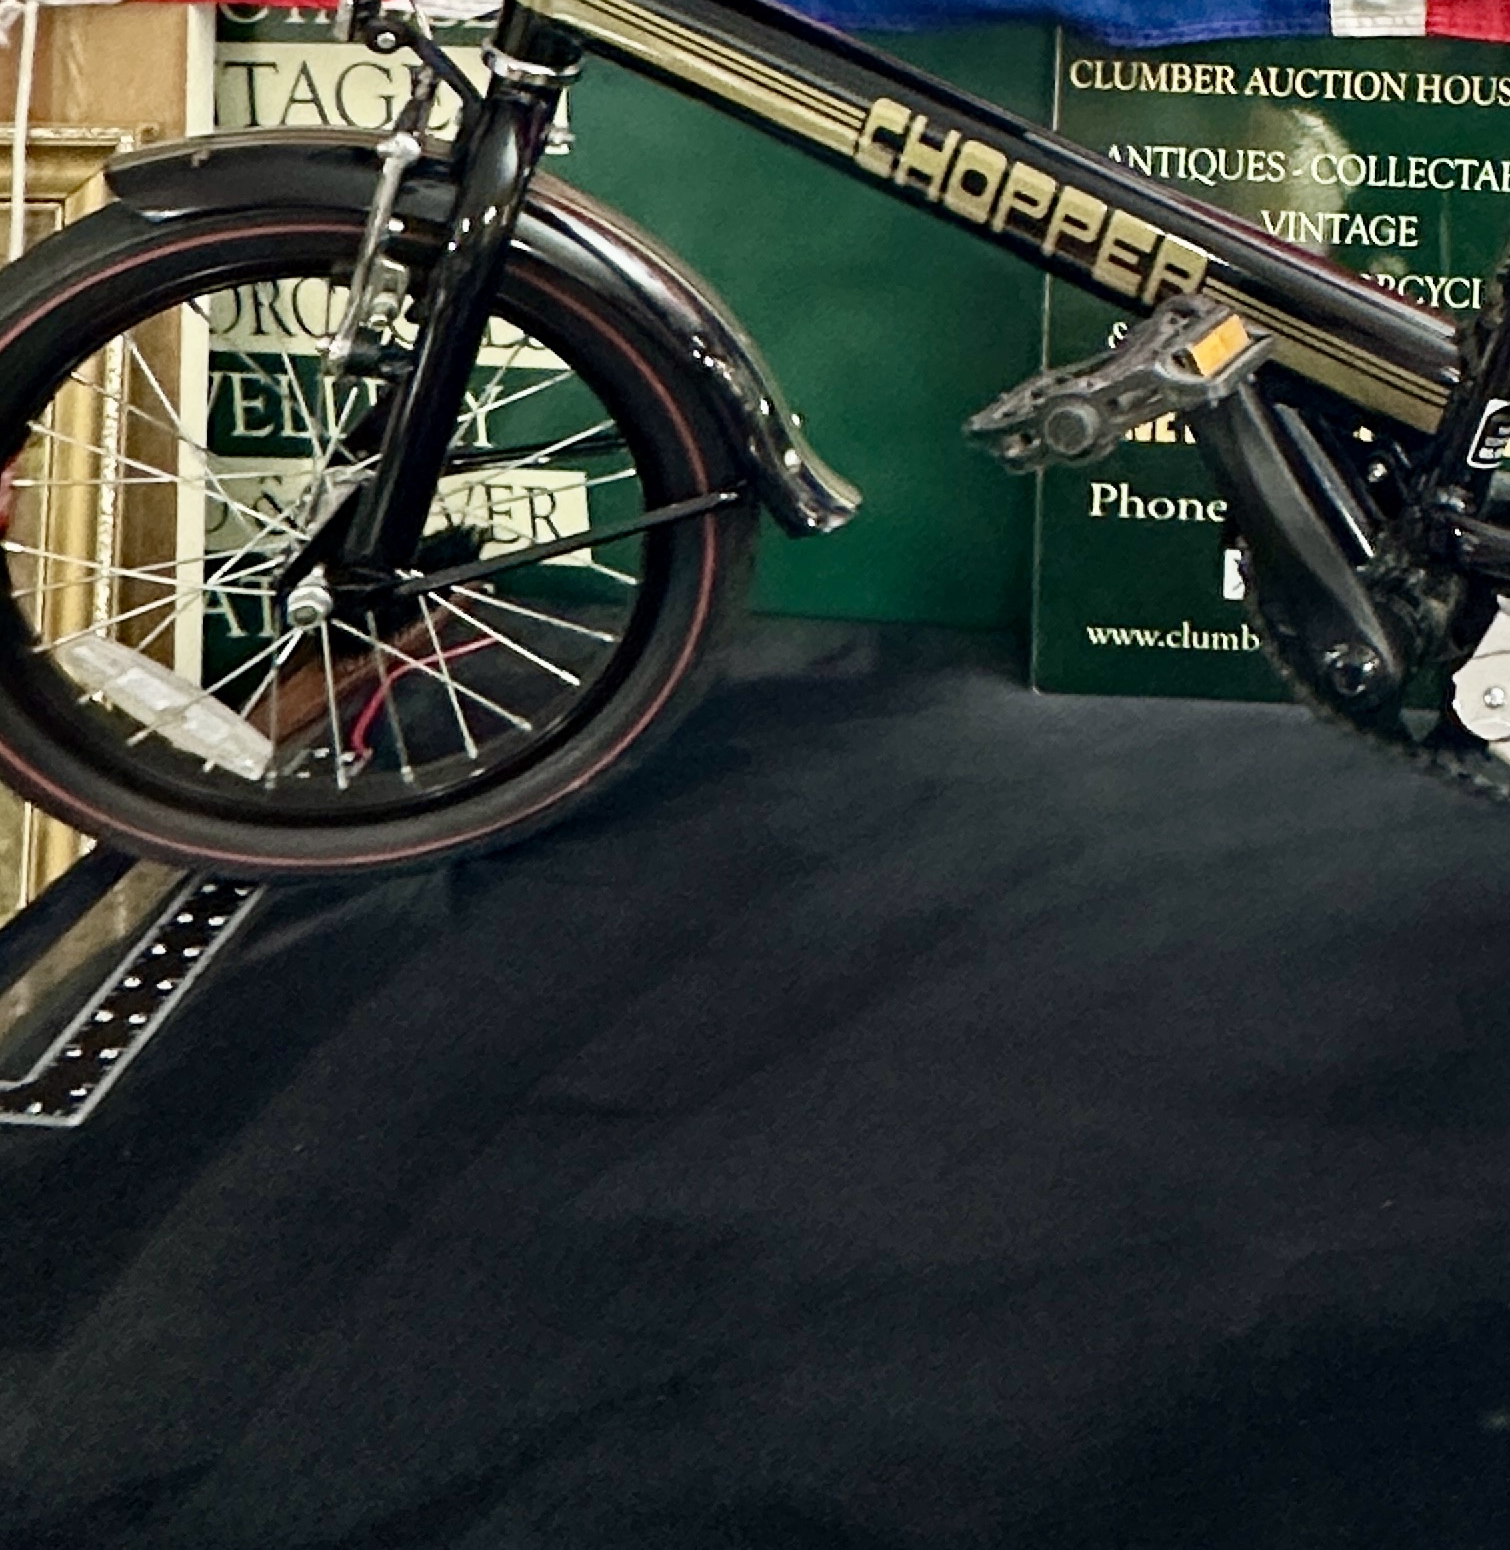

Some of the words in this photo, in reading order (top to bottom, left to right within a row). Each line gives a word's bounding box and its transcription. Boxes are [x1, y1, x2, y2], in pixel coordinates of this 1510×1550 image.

[1069, 59, 1236, 96] CLUMBER
[1245, 66, 1406, 102] AUCTION
[855, 97, 1209, 308] CHOPPER
[1261, 208, 1419, 247] VINTAGE
[1089, 481, 1229, 523] Phone
[1086, 620, 1262, 651] www.clumb
